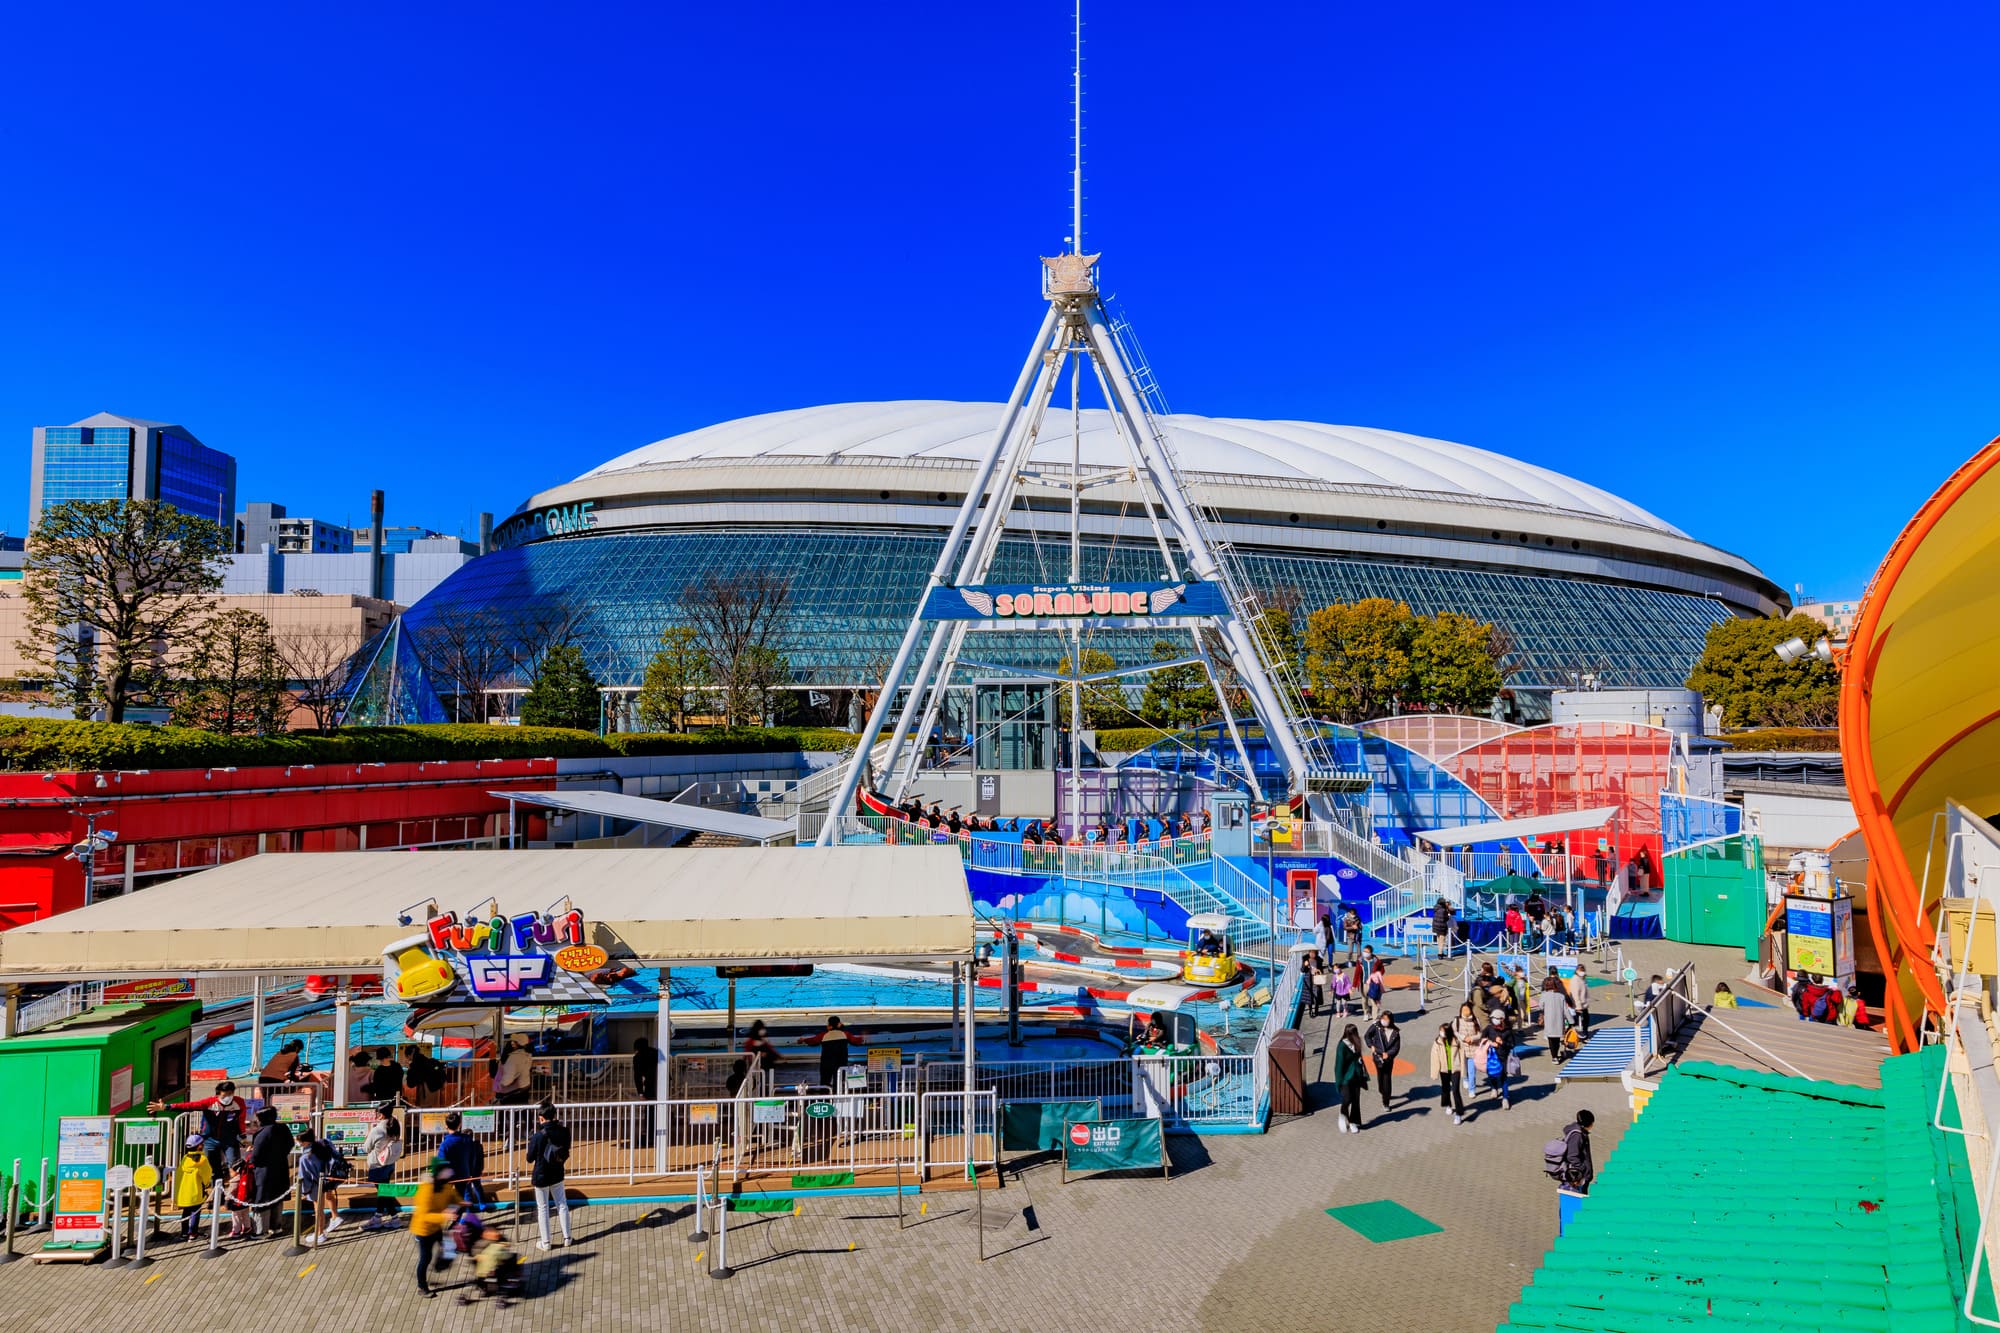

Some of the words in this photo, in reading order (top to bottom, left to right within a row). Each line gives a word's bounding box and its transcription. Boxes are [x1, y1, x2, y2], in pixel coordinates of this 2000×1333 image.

[1071, 585, 1110, 593] Viking
[995, 591, 1148, 616] SORABUNE
[428, 912, 504, 951] Furi
[511, 908, 584, 950] Furi
[560, 948, 591, 959] フリフリ
[565, 956, 602, 968] グランプリ
[469, 956, 550, 995] GP
[1092, 1126, 1121, 1141] 出口
